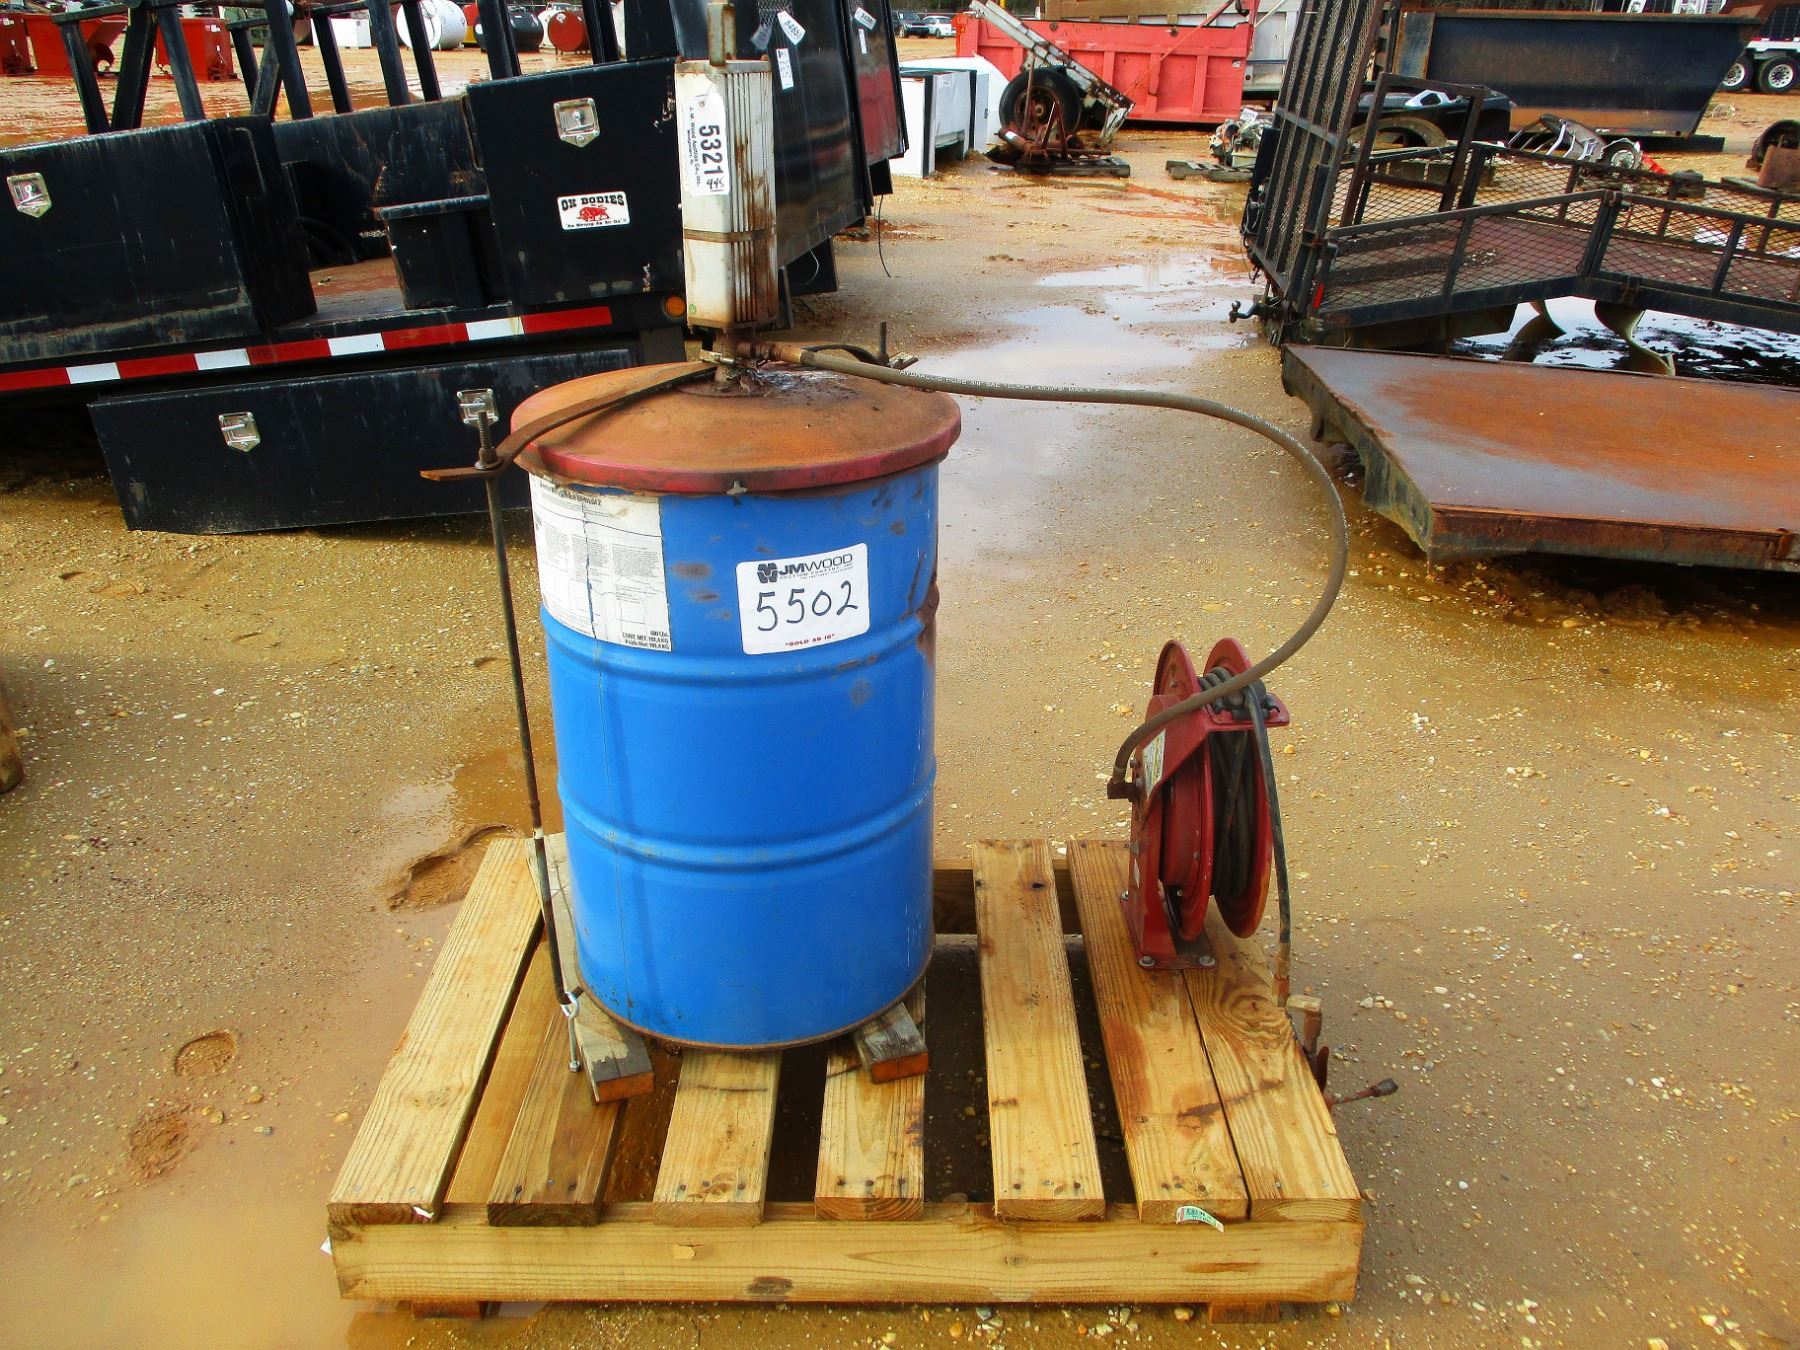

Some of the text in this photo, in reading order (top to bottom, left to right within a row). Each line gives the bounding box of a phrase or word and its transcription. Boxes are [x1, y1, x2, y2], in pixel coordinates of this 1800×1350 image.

[699, 125, 724, 175] 5321
[561, 194, 625, 211] OX BODIES
[757, 580, 858, 631] 5502
